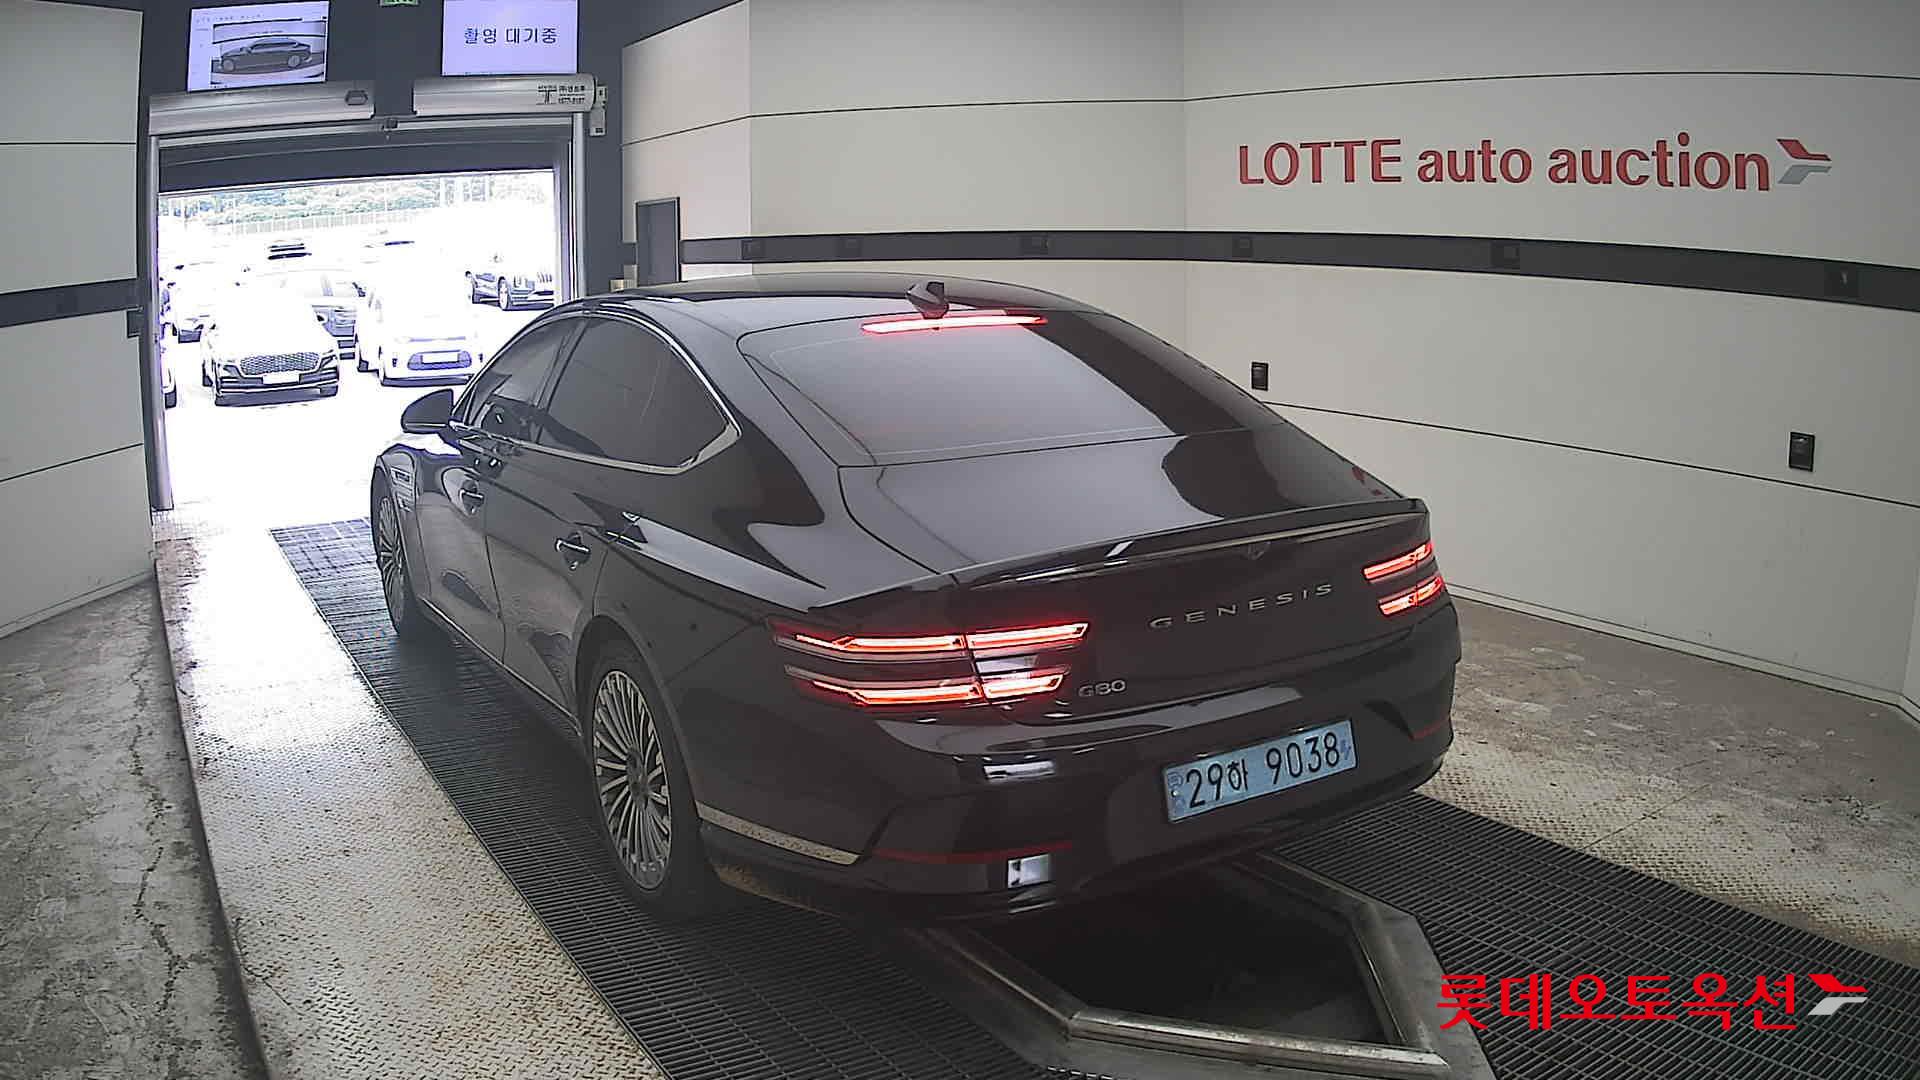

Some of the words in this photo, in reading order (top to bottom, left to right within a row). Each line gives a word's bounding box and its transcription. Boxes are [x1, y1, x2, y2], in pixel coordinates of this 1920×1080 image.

[464, 28, 497, 44] 촬영
[505, 28, 557, 44] 대기중
[1238, 139, 1403, 186] LOTTE
[1417, 139, 1532, 183] auto
[1547, 131, 1770, 191] auction
[1150, 583, 1333, 629] GENESIS
[1078, 679, 1126, 697] G80
[1186, 758, 1249, 808] 29하
[1266, 732, 1340, 785] 9038
